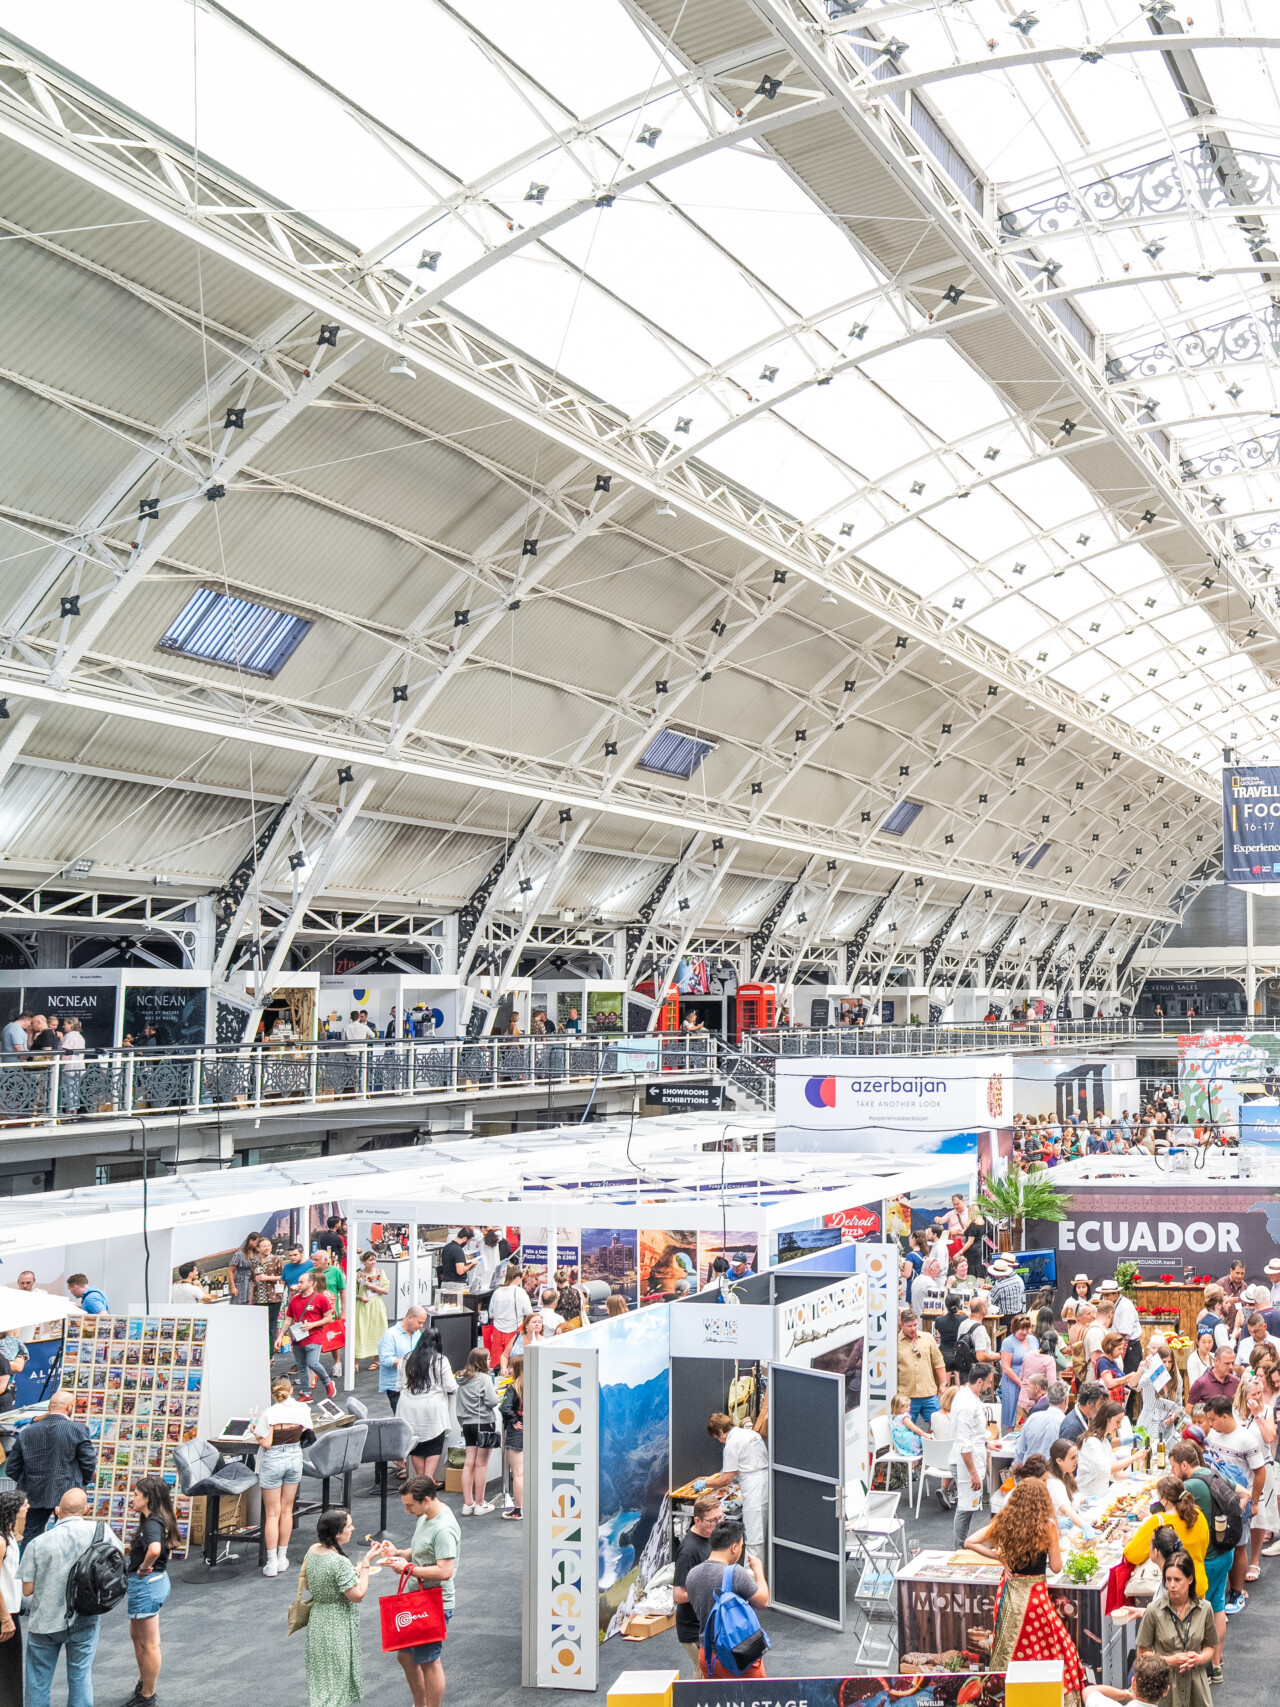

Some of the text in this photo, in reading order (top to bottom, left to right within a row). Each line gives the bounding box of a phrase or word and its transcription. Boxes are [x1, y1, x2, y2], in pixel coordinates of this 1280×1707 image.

[1244, 822, 1275, 832] 16-17
[662, 1088, 709, 1096] SHOWROOMS
[851, 1077, 946, 1097] azerbaijan
[662, 1096, 709, 1104] EXHIBITIONS
[827, 1211, 876, 1228] Detroit
[841, 1227, 864, 1236] PIZZA
[1058, 1221, 1242, 1253] ECUADOR
